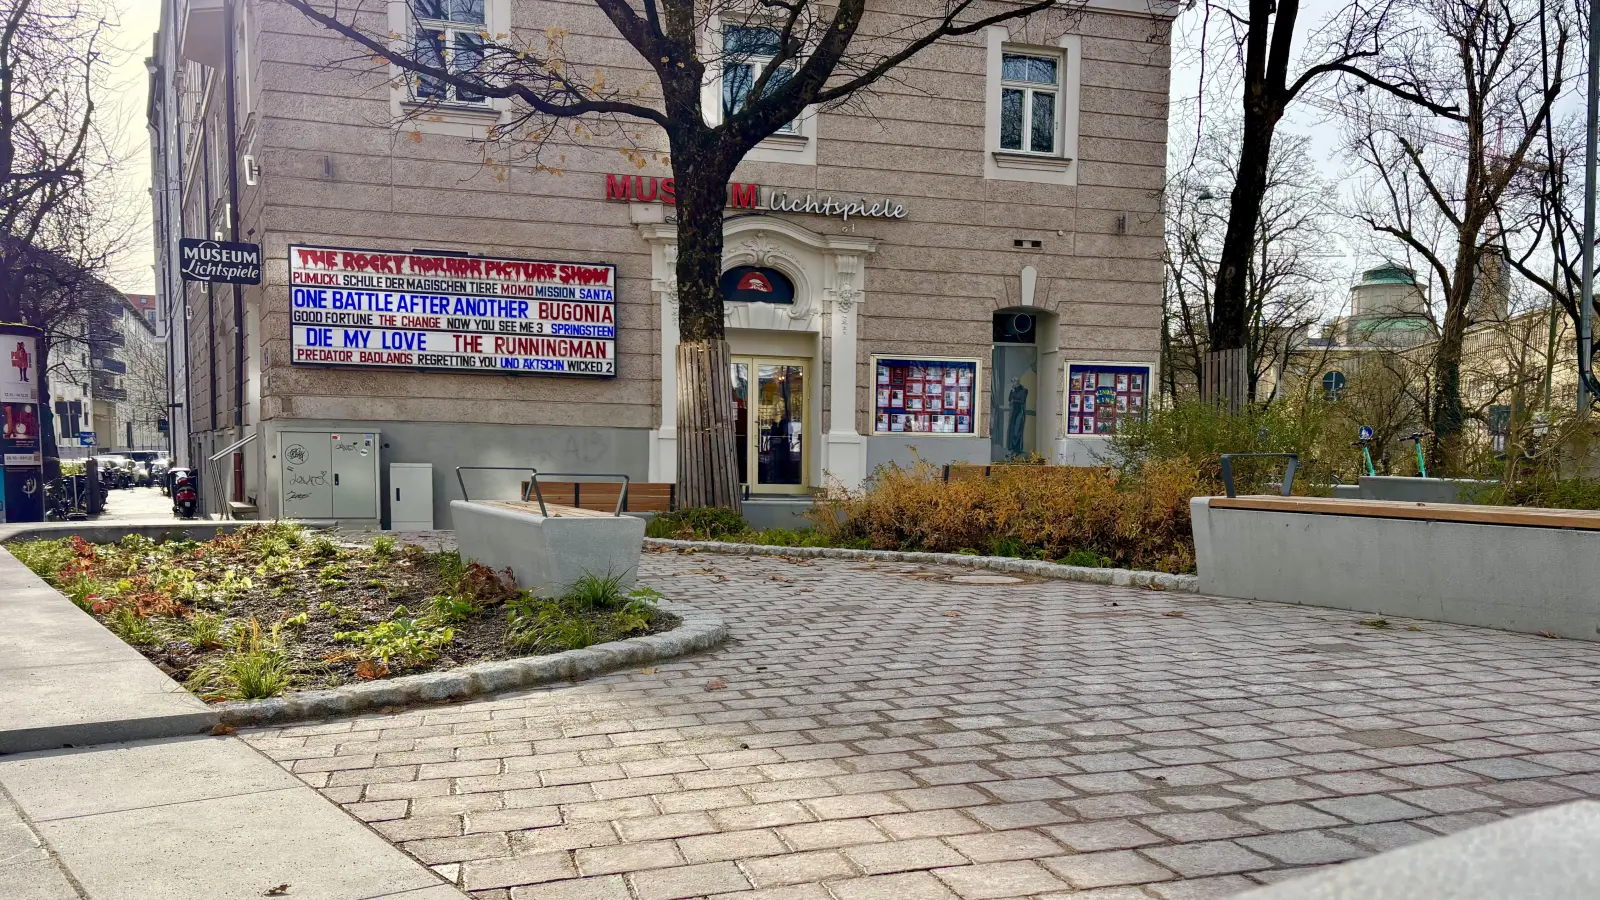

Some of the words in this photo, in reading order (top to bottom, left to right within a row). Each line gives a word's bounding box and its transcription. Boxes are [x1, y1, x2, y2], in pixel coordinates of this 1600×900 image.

[606, 173, 756, 208] MUSM
[184, 246, 258, 264] MUSEUM
[297, 249, 338, 270] THE
[343, 251, 406, 275] ROCKY
[409, 255, 482, 279] HORROR
[484, 260, 557, 282] PICTURE
[559, 265, 610, 285] SHOW
[182, 260, 258, 280] Lichtspiele
[293, 272, 341, 285] PUMUCKL
[343, 274, 382, 288] SCHULE
[386, 277, 404, 289] DER
[406, 279, 466, 292] MAGISCHEN
[470, 282, 498, 294] TIERE
[501, 284, 534, 296] MOMO
[536, 286, 575, 298] MISSION
[580, 288, 612, 300] SANTA
[294, 289, 327, 308] ONE
[332, 291, 393, 312] BATTLE
[397, 294, 450, 314] AFTER
[453, 298, 528, 318] ANOTHER
[538, 302, 613, 323] BUGONIA
[294, 311, 322, 322] GOOD
[326, 312, 373, 325] FORTUNE
[379, 314, 396, 326] THE
[401, 316, 440, 328] CHANGE
[447, 318, 470, 330] NOW
[474, 319, 494, 330] YOU
[499, 320, 517, 331] SEE
[520, 322, 534, 333] ME
[537, 323, 543, 333] 3
[551, 323, 614, 337] SPRINGSTEEN
[306, 328, 332, 347] DIE
[344, 329, 371, 348] MY
[382, 331, 426, 350] LOVE
[453, 334, 483, 353] THE
[298, 349, 352, 361] PREDATOR
[360, 351, 413, 364] BADLANDS
[418, 354, 475, 367] REGRETTING
[478, 356, 496, 368] YOU
[500, 357, 519, 368] UND
[567, 360, 602, 372] WICKED
[606, 362, 612, 372] 2
